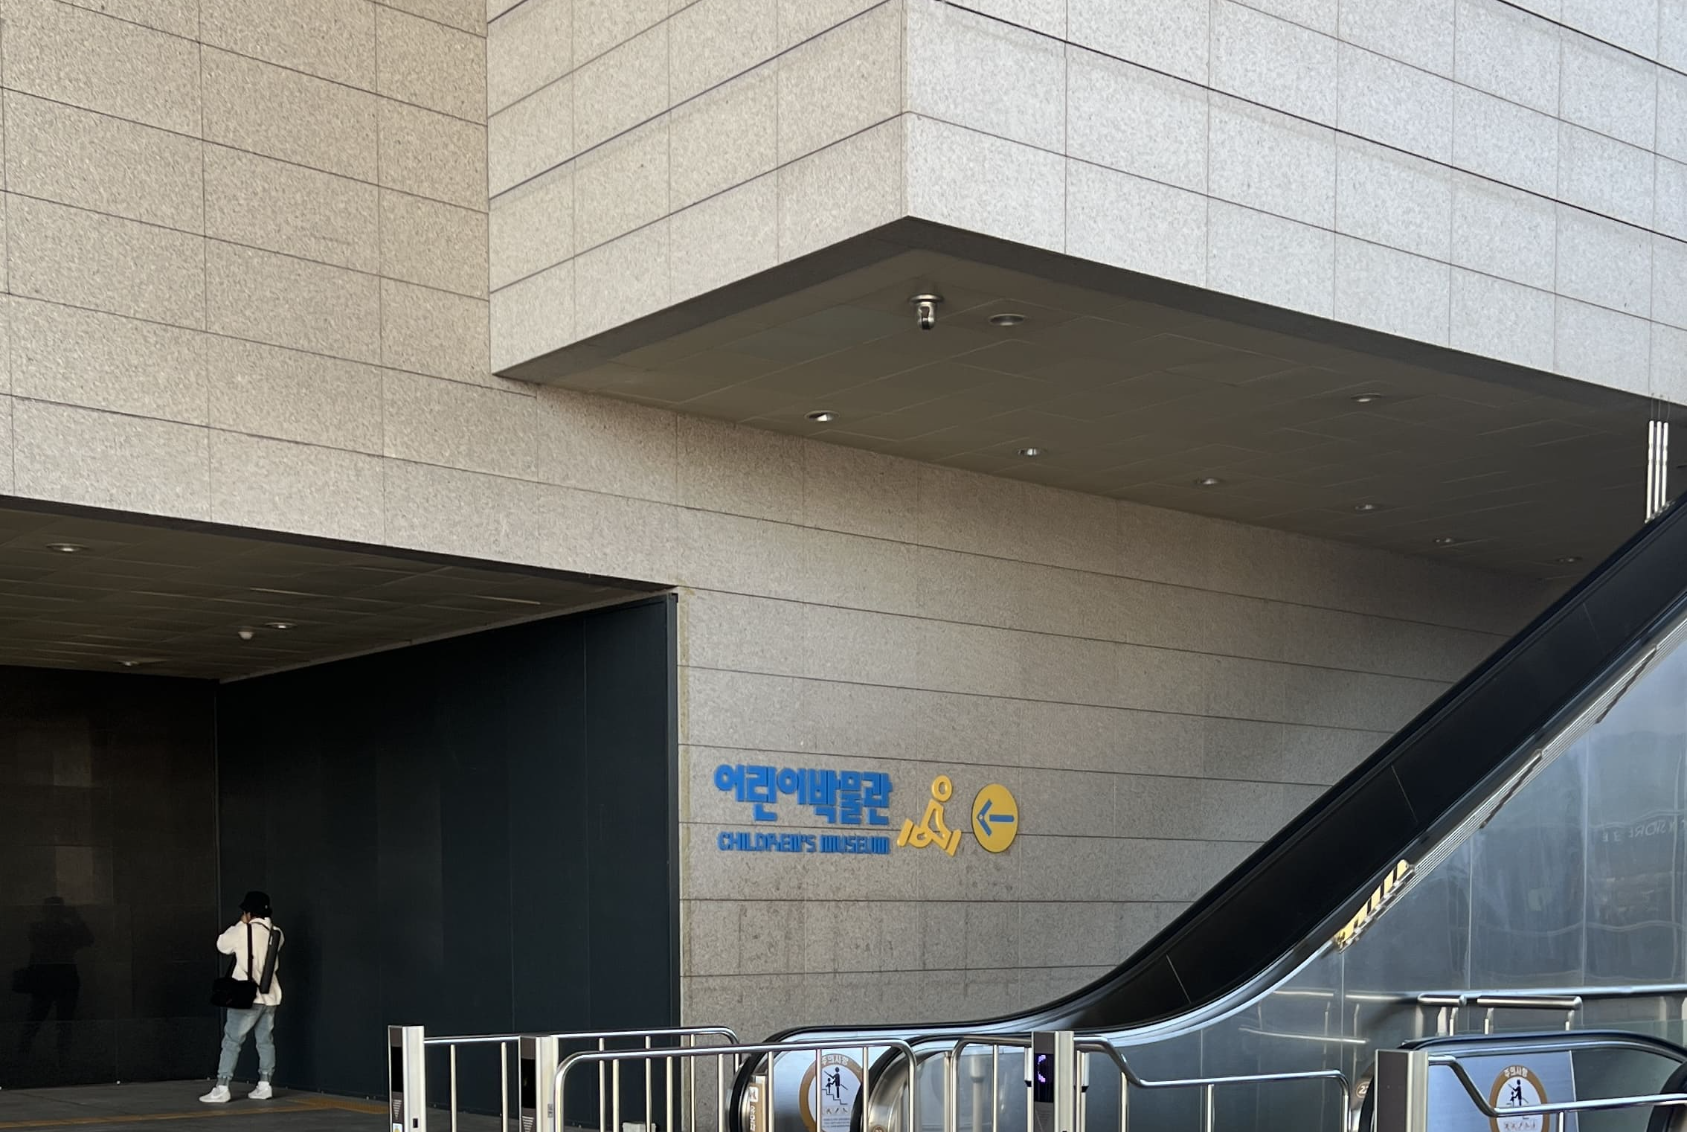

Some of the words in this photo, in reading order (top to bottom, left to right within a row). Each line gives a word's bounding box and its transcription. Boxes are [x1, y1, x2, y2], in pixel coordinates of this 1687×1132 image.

[714, 764, 893, 825] 어린이박물관
[717, 831, 815, 852] CHILDREN'S
[819, 834, 890, 854] MUSEUM
